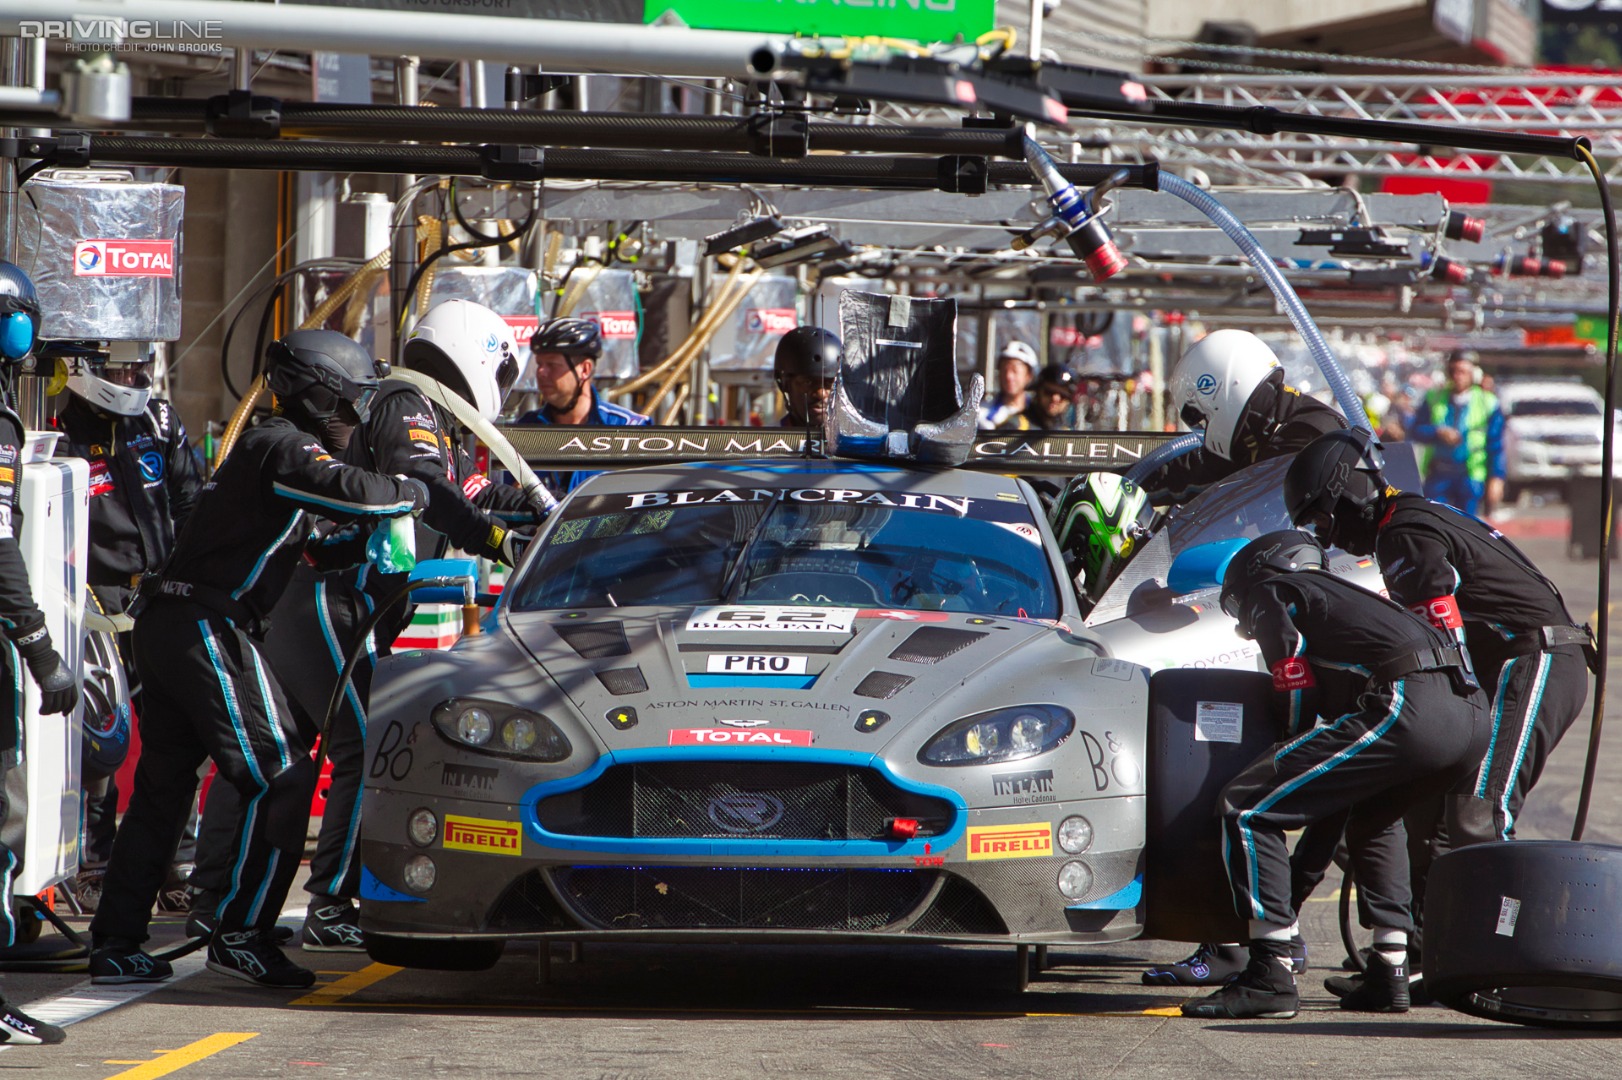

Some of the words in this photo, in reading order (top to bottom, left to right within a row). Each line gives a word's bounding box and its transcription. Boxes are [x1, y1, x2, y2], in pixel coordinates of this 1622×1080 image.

[106, 247, 172, 269] TOTAL
[158, 402, 169, 430] HRX
[559, 437, 708, 451] ASTON
[975, 441, 1143, 459] GALLEN
[625, 489, 975, 517] BLANCPAIN
[717, 610, 827, 623] 62
[693, 622, 845, 631] BLANCPAIN
[724, 655, 790, 672] PRO
[646, 700, 698, 710] ASTON
[703, 699, 763, 708] MARTIN
[791, 701, 850, 712] GALLEN
[690, 729, 792, 744] TOTAL
[445, 821, 518, 849] PIRELLI
[970, 829, 1050, 853] PIRELLI
[914, 856, 945, 867] TOW
